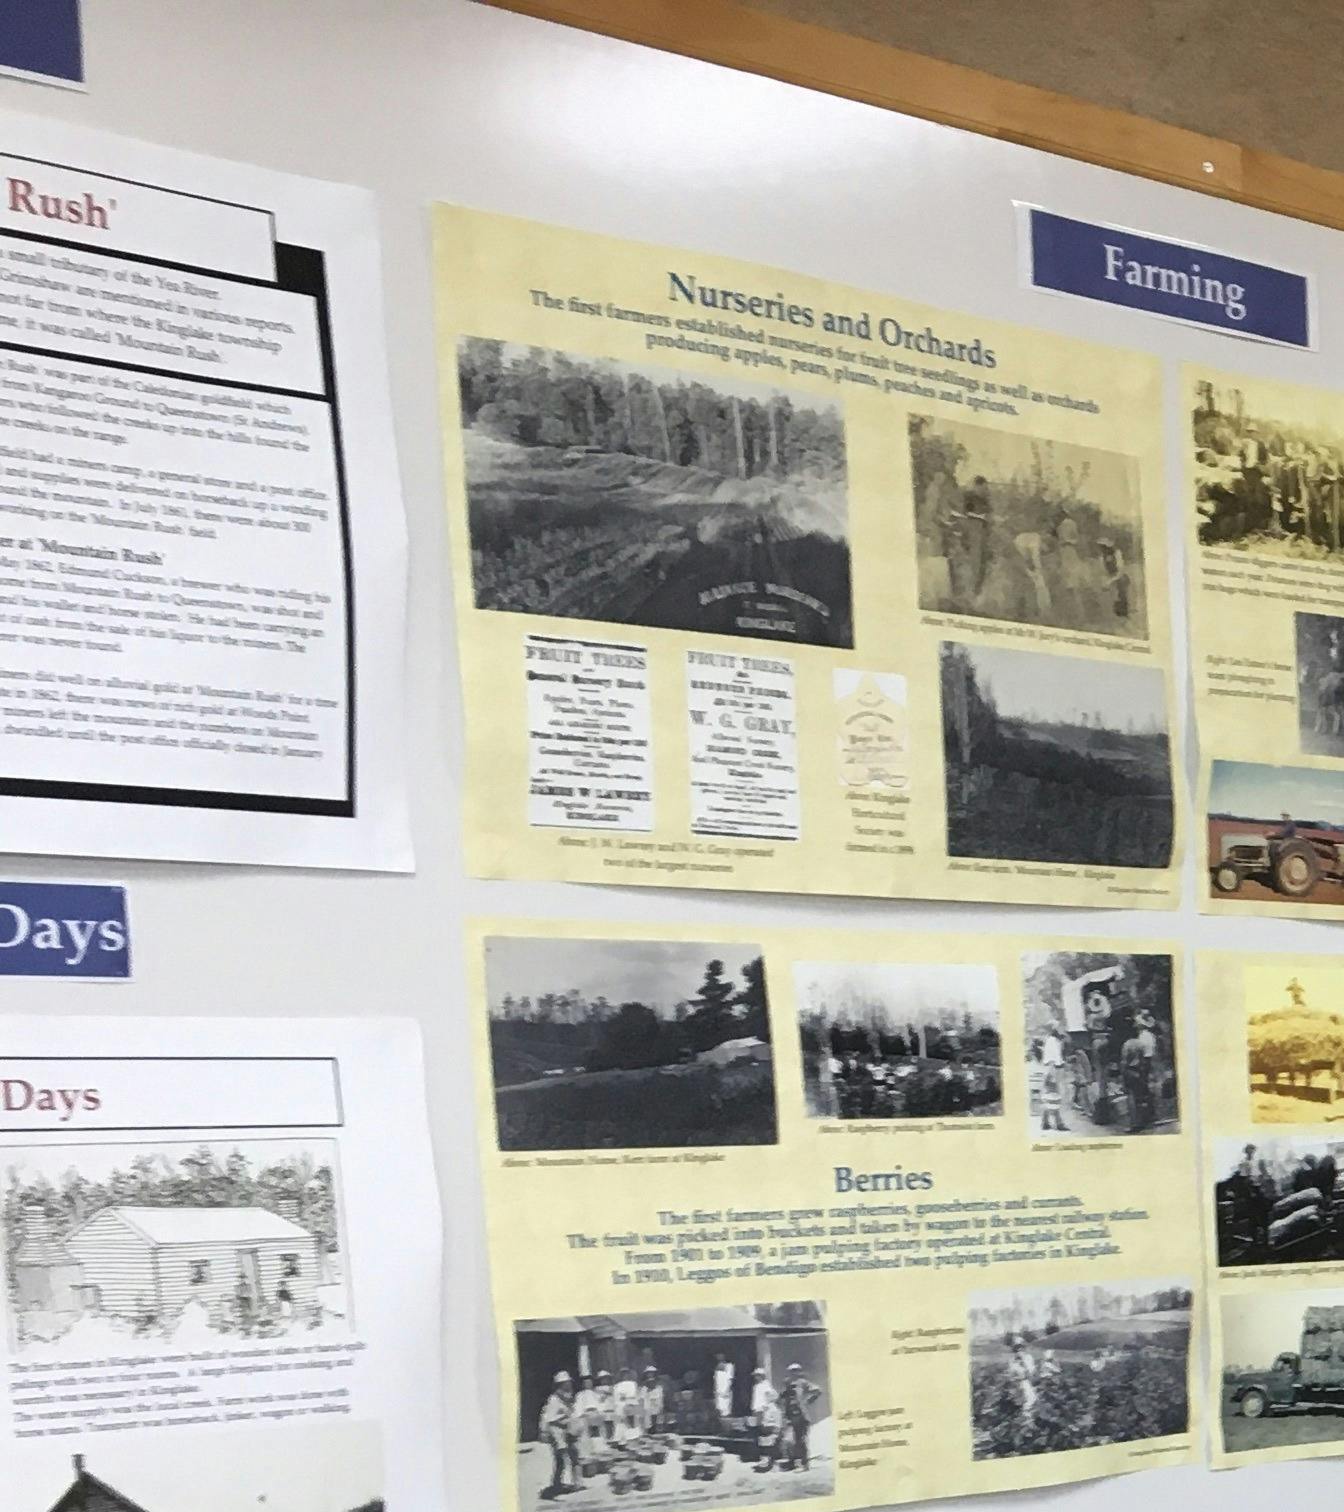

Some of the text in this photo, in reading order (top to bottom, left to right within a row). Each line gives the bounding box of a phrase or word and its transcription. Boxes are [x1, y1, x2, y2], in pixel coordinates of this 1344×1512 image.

[1103, 244, 1246, 320] Farming
[529, 290, 564, 309] The
[568, 296, 602, 315] first
[607, 303, 671, 328] farmers
[676, 317, 765, 344] established
[667, 271, 998, 369] Nurseries and Orchards
[646, 332, 729, 361] producing
[1, 1079, 102, 1122] Days
[833, 1164, 933, 1193] Berries
